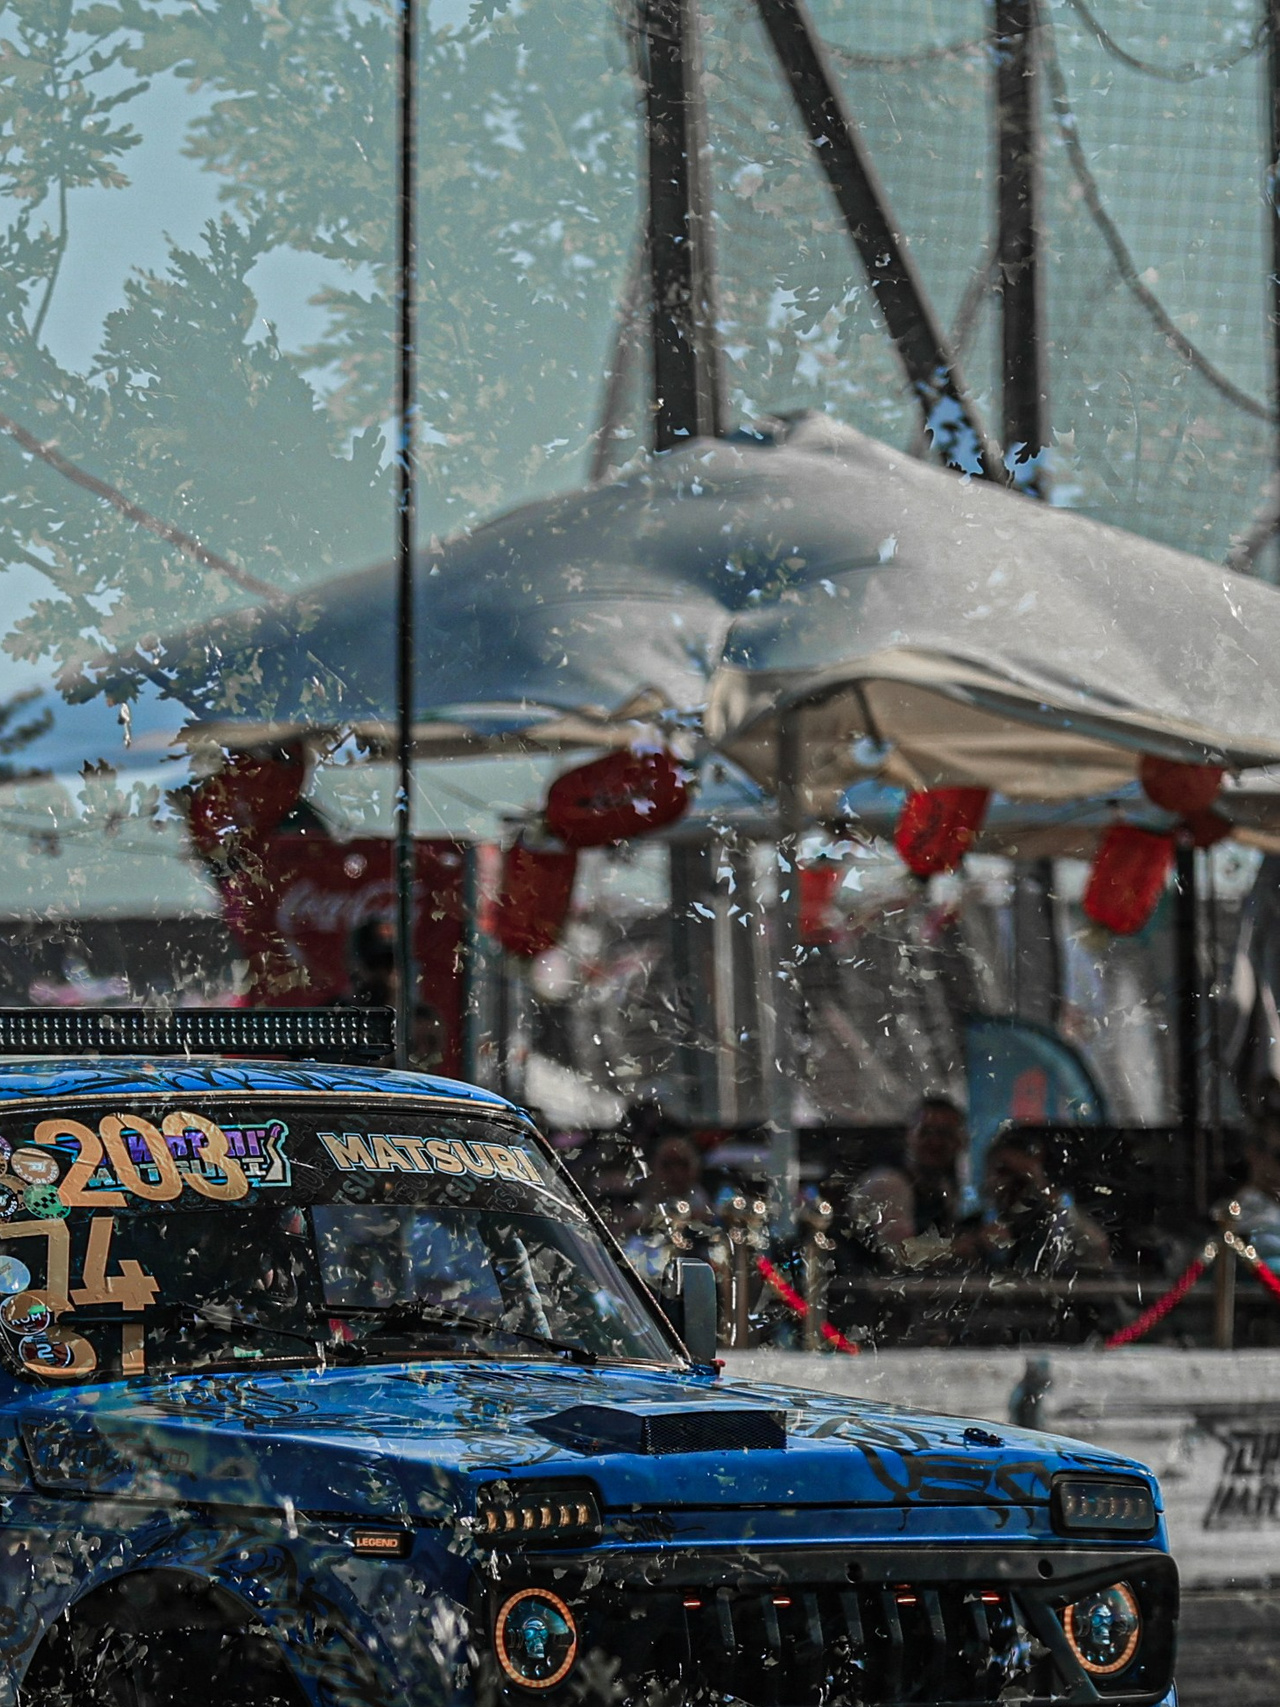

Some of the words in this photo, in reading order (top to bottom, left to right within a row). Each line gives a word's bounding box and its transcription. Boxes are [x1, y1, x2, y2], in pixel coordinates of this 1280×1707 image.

[34, 1111, 249, 1207] 203
[317, 1132, 546, 1186] MATSURI
[356, 1537, 399, 1548] LEGEND
